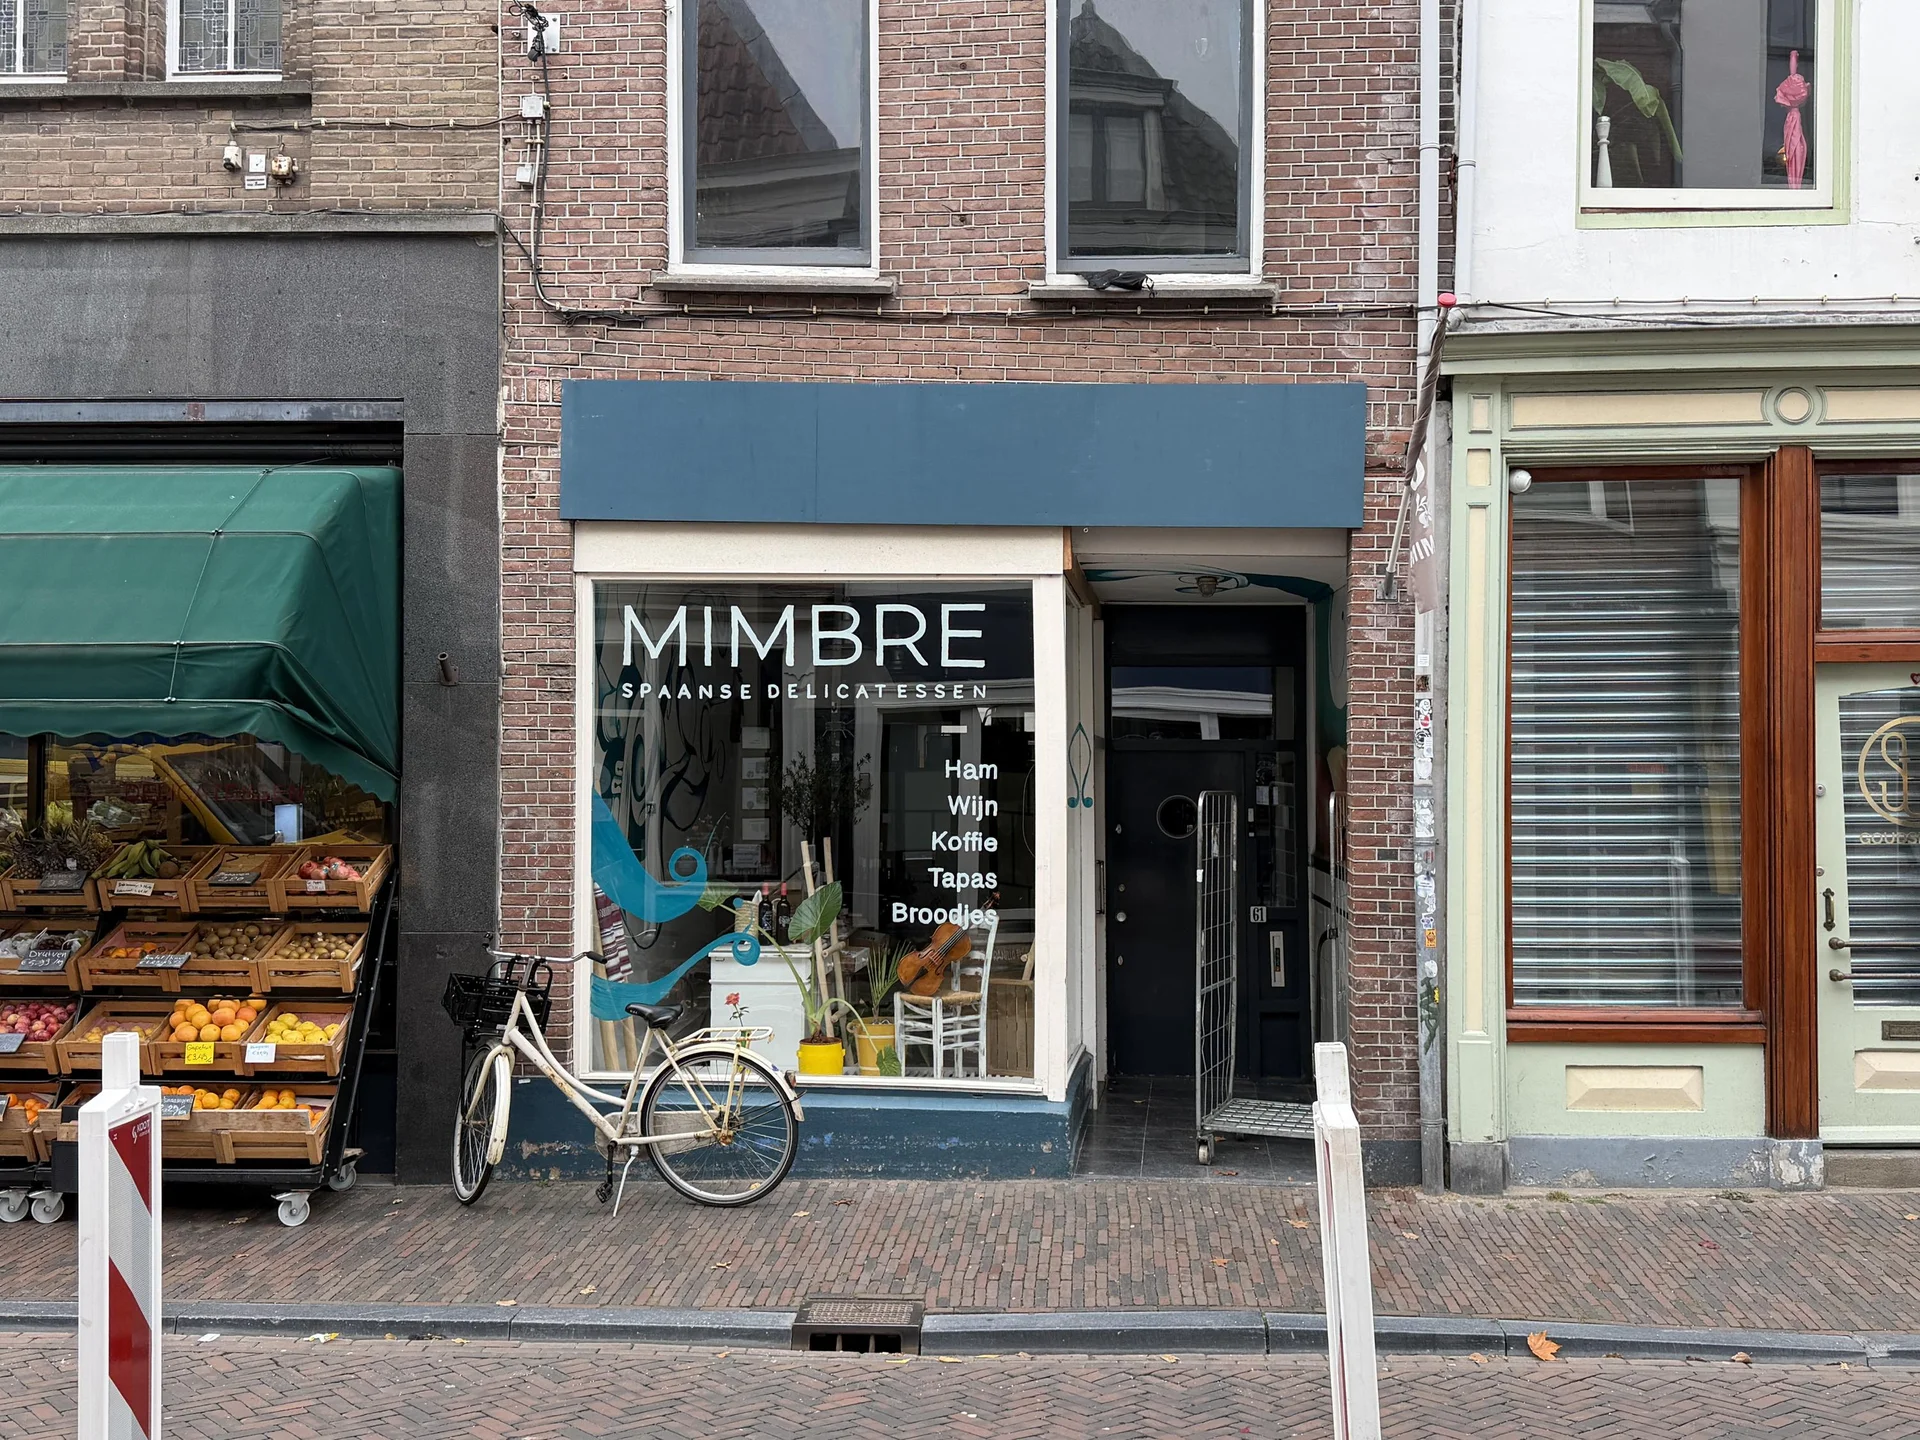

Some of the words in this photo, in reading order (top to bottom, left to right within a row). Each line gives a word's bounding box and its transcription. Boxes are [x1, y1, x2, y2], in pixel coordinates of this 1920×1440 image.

[622, 603, 987, 667] MIMBRE
[622, 682, 753, 700] SPAANSE
[766, 683, 987, 700] DELICATESSEN
[945, 759, 998, 780] Ham
[947, 794, 998, 821] Wijn
[931, 831, 998, 852] Koffie
[1860, 832, 1920, 845] GOUDS
[928, 867, 998, 892] Tapas
[892, 902, 998, 930] Broodjes
[1252, 907, 1265, 921] 61
[29, 950, 67, 958] Druiven
